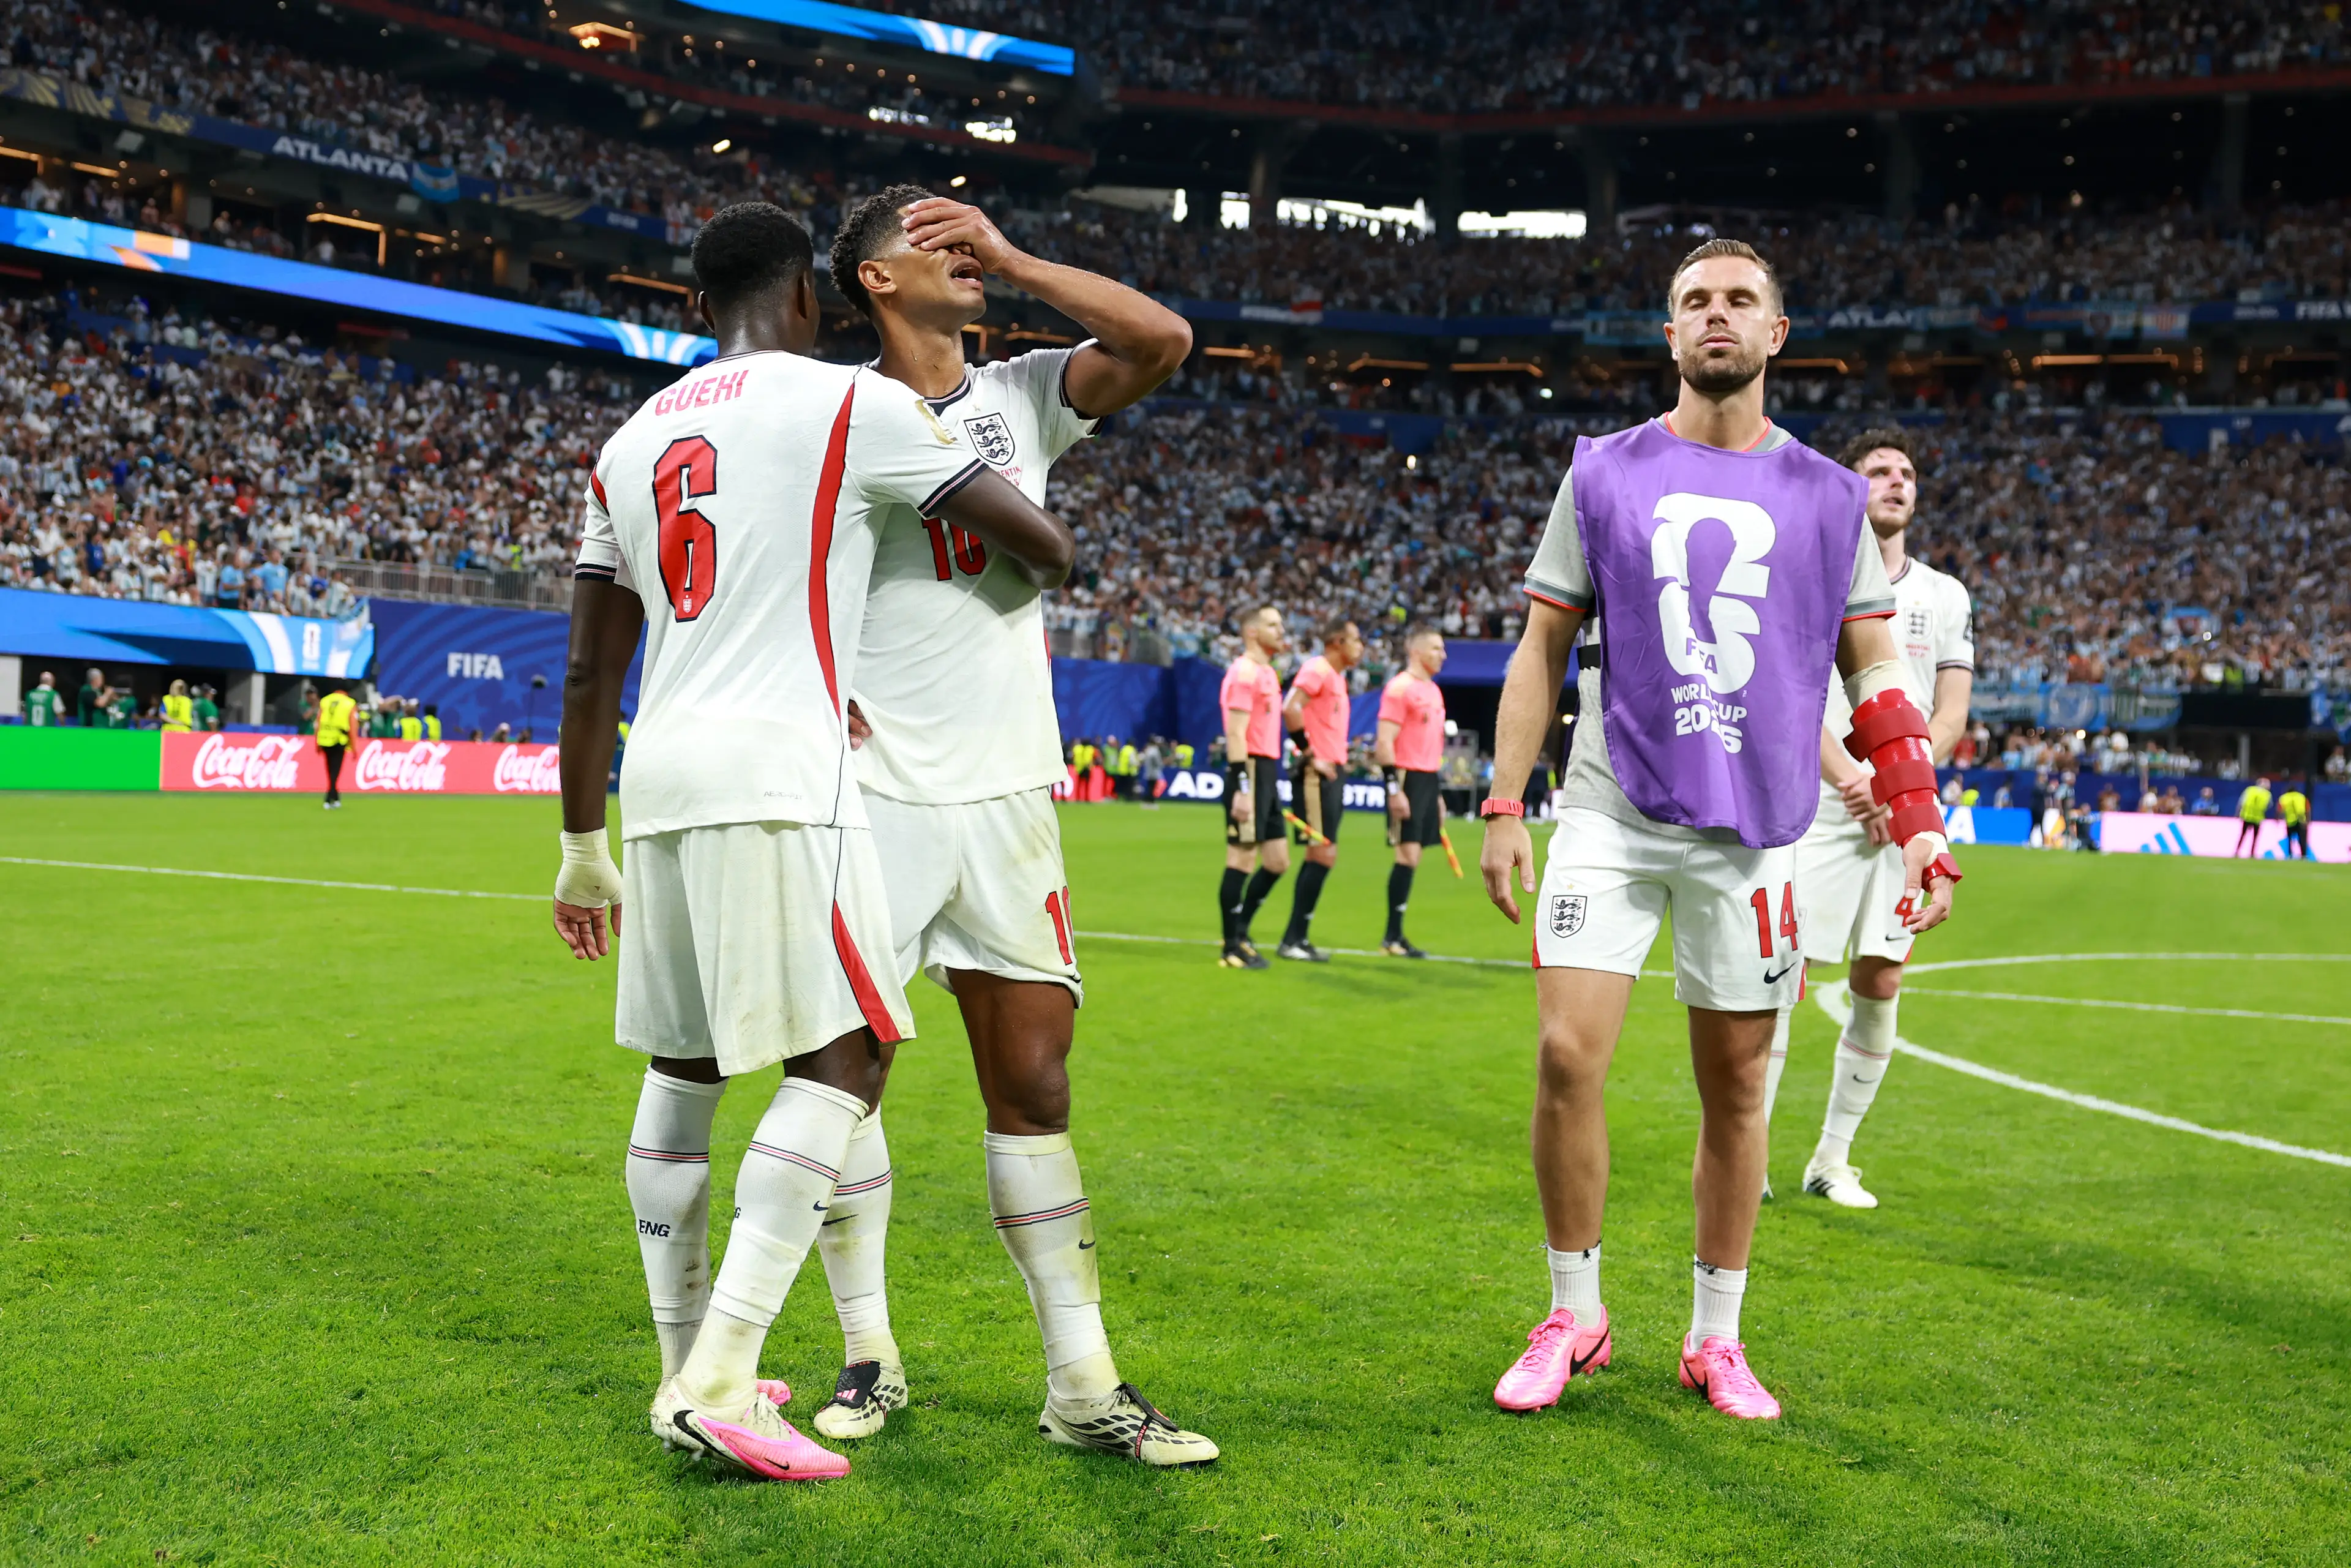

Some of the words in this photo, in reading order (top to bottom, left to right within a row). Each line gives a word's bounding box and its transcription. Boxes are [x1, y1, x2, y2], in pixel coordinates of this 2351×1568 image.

[272, 136, 409, 182] ATLANTA
[1828, 306, 1913, 328] ATLA
[655, 369, 749, 416] GUEHI
[652, 435, 718, 623] 6
[921, 517, 986, 581] 10
[447, 652, 504, 681] FIFA
[1686, 637, 1718, 674] FA
[1671, 683, 1715, 704] WORL
[1712, 699, 1747, 722] CUP
[1674, 704, 1743, 754] 2026
[1750, 880, 1798, 958] 14
[639, 1218, 671, 1237] ENG
